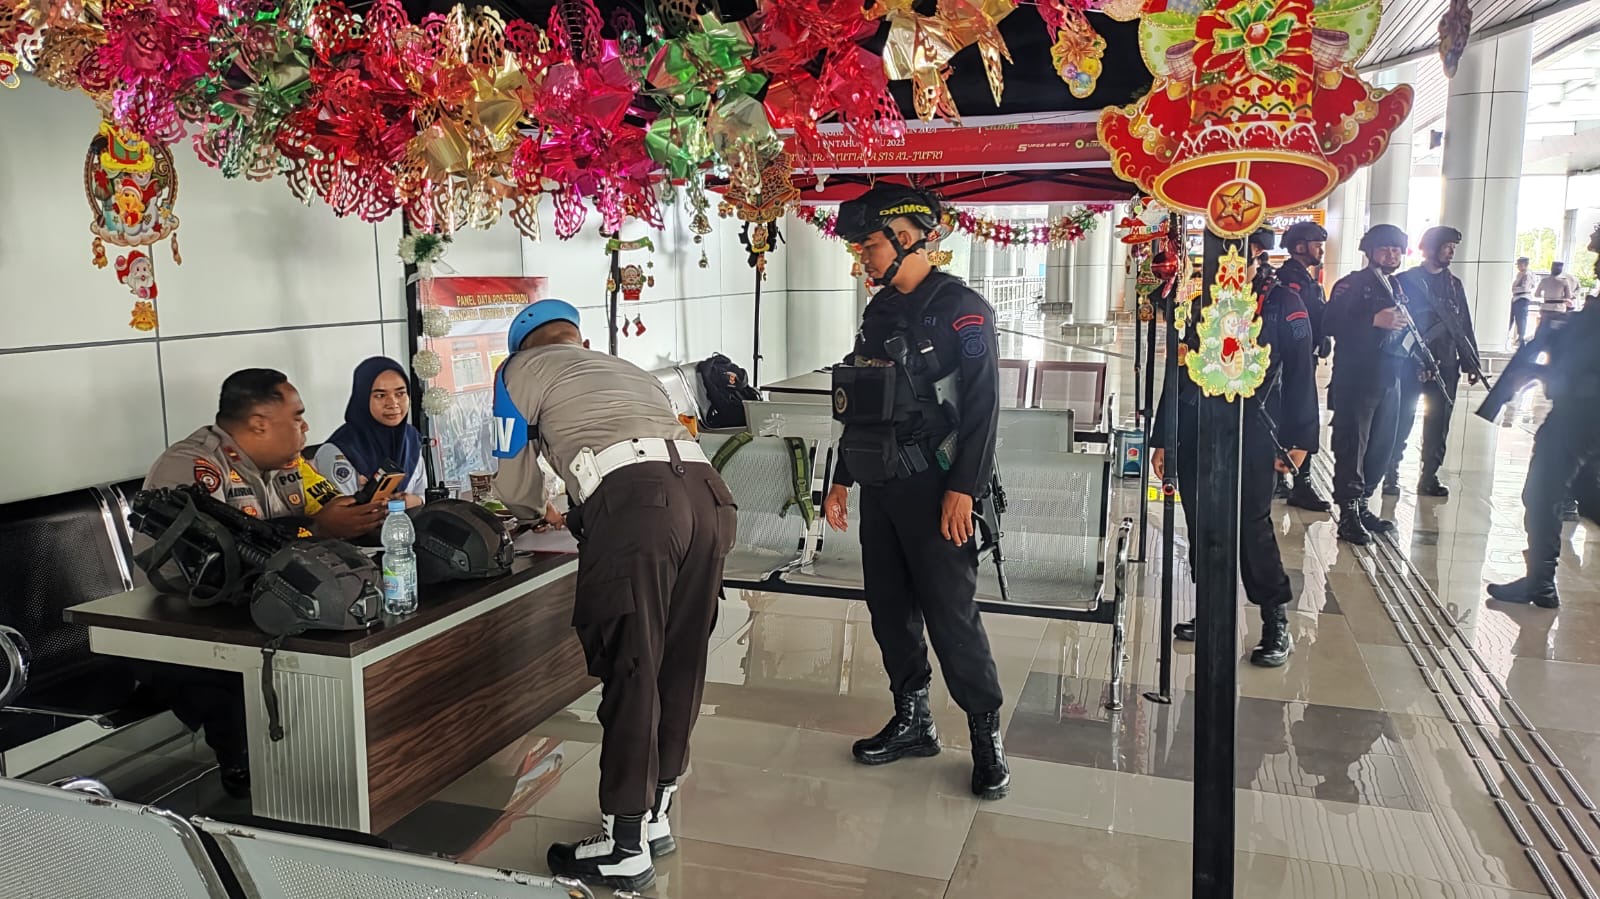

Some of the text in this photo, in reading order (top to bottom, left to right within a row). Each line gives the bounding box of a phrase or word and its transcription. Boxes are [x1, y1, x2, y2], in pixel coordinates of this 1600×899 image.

[895, 150, 944, 161] AL-JUFRI
[879, 204, 932, 215] BRIMOB
[456, 295, 477, 306] PANEL
[477, 294, 492, 305] DATA
